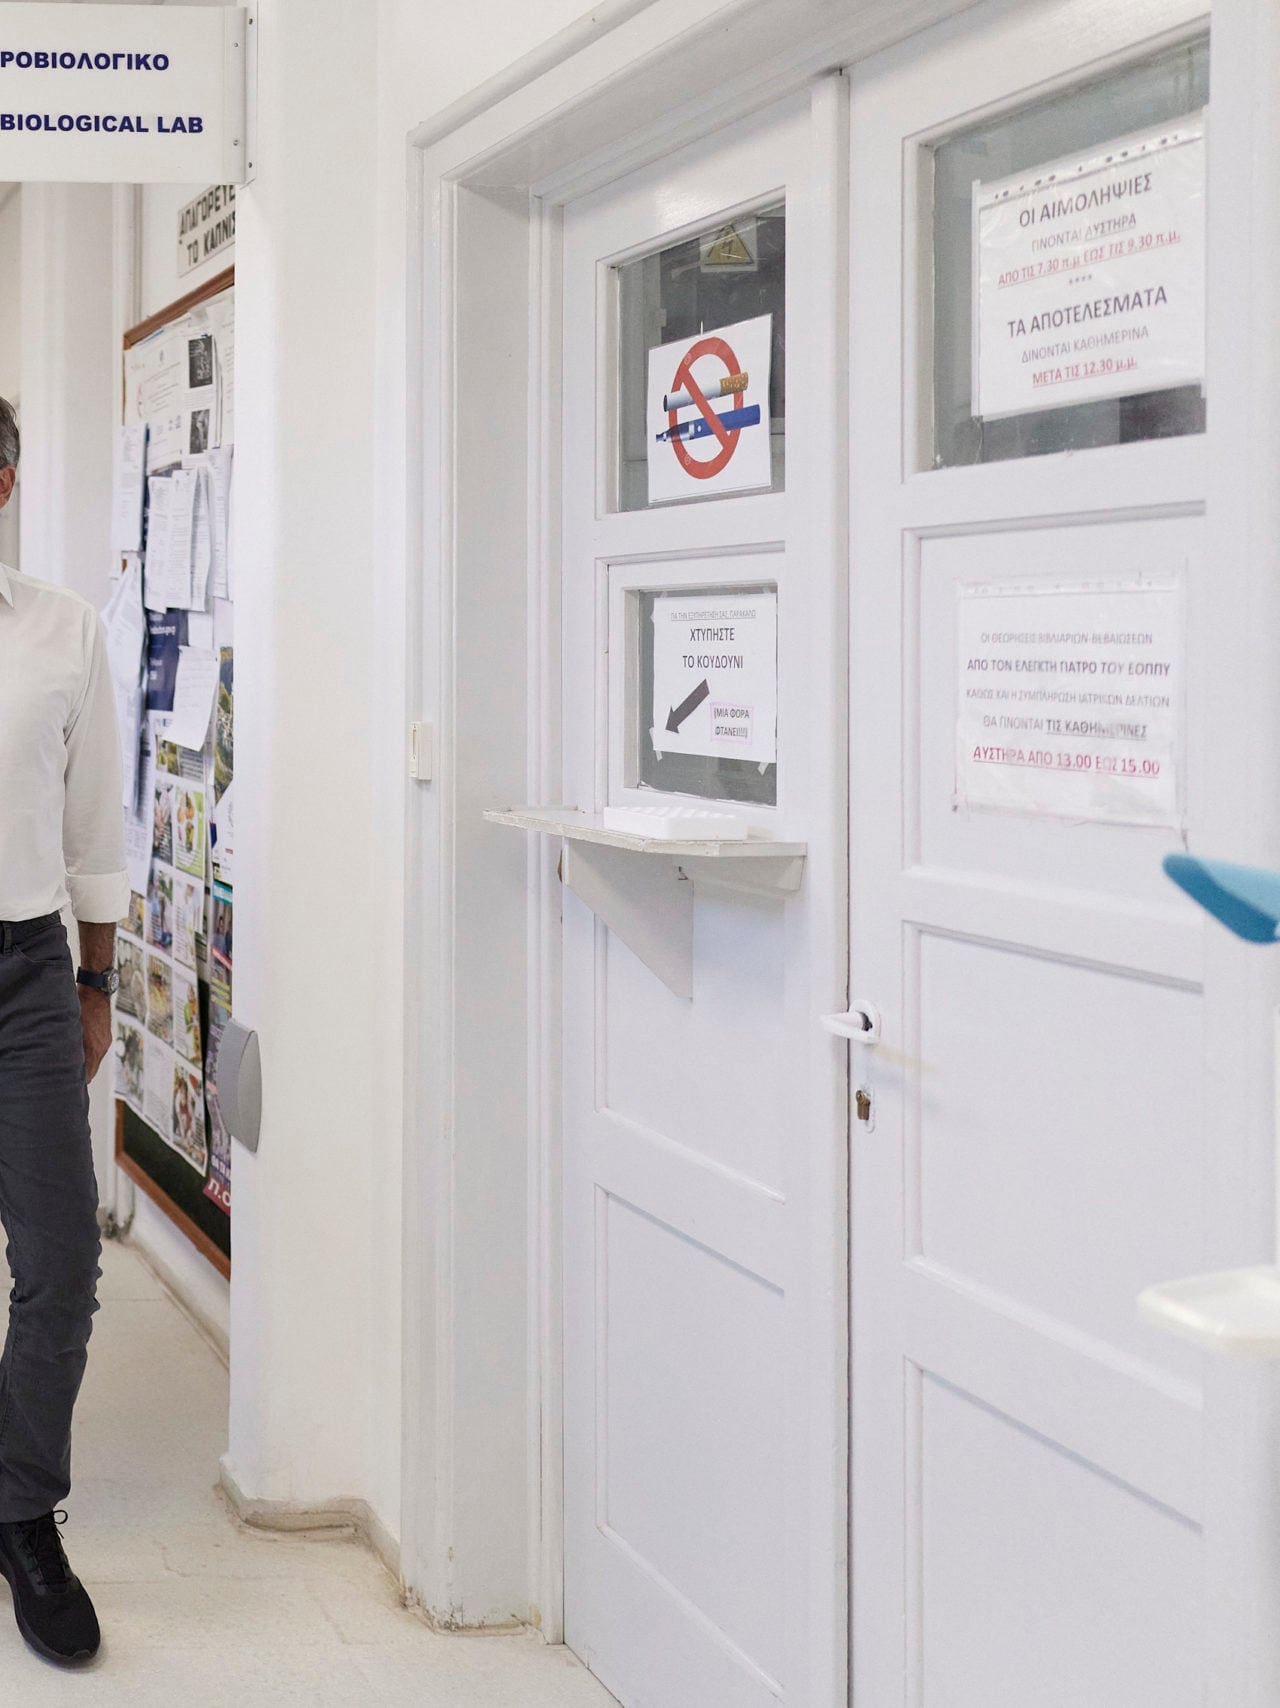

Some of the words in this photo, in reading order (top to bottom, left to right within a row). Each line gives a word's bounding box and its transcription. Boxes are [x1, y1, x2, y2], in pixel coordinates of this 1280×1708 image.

[157, 116, 204, 134] LAB
[1019, 207, 1035, 228] ΟΙ
[1040, 172, 1152, 222] ΑΙΜΟΛΗΨΙΕΣ
[1085, 213, 1137, 239] ΑΥΣΤΗΡΑ
[187, 239, 199, 266] ΤΟ
[998, 268, 1019, 286] ΑΠΟ
[1022, 265, 1035, 280] ΤΙΣ
[1083, 247, 1104, 263] ΕΩΣ
[1109, 241, 1124, 257] ΤΙΣ
[1008, 319, 1026, 339] ΤΑ
[1030, 286, 1167, 333] ΑΠΟΤΕΛΕΣΜΑΤΑ
[1021, 344, 1071, 363] ΔΙΝΟΝΤΑΙ
[1073, 326, 1149, 353] ΚΑΘΗΜΕΡΙΝΑ
[1032, 368, 1062, 385] ΜΕΤΑ
[1064, 365, 1080, 379] ΤΙΣ
[1084, 358, 1112, 376] 12.30
[690, 627, 735, 641] ΧΤΥΠΗΣΤΕ
[682, 655, 695, 668] ΤΟ
[697, 655, 744, 669] ΚΟΥΔΟΥΝΙ
[967, 659, 988, 671] ΑΠΟ
[990, 659, 1012, 672] ΤΟΝ
[1016, 660, 1056, 673] ΕΛΕΓΚΤΗ
[1060, 660, 1097, 674] ΓΙΑΤΡΟ
[1101, 662, 1123, 674] ΤΟΥ
[1128, 662, 1170, 676] ΕΟΠΠΥ
[730, 708, 749, 718] ΦΟΡΑ
[983, 715, 997, 727] ΘΑ
[1046, 719, 1061, 732] ΤΙΣ
[1028, 751, 1052, 765] ΑΠΟ
[1057, 753, 1091, 769] 13.00
[1121, 758, 1160, 775] 15.00
